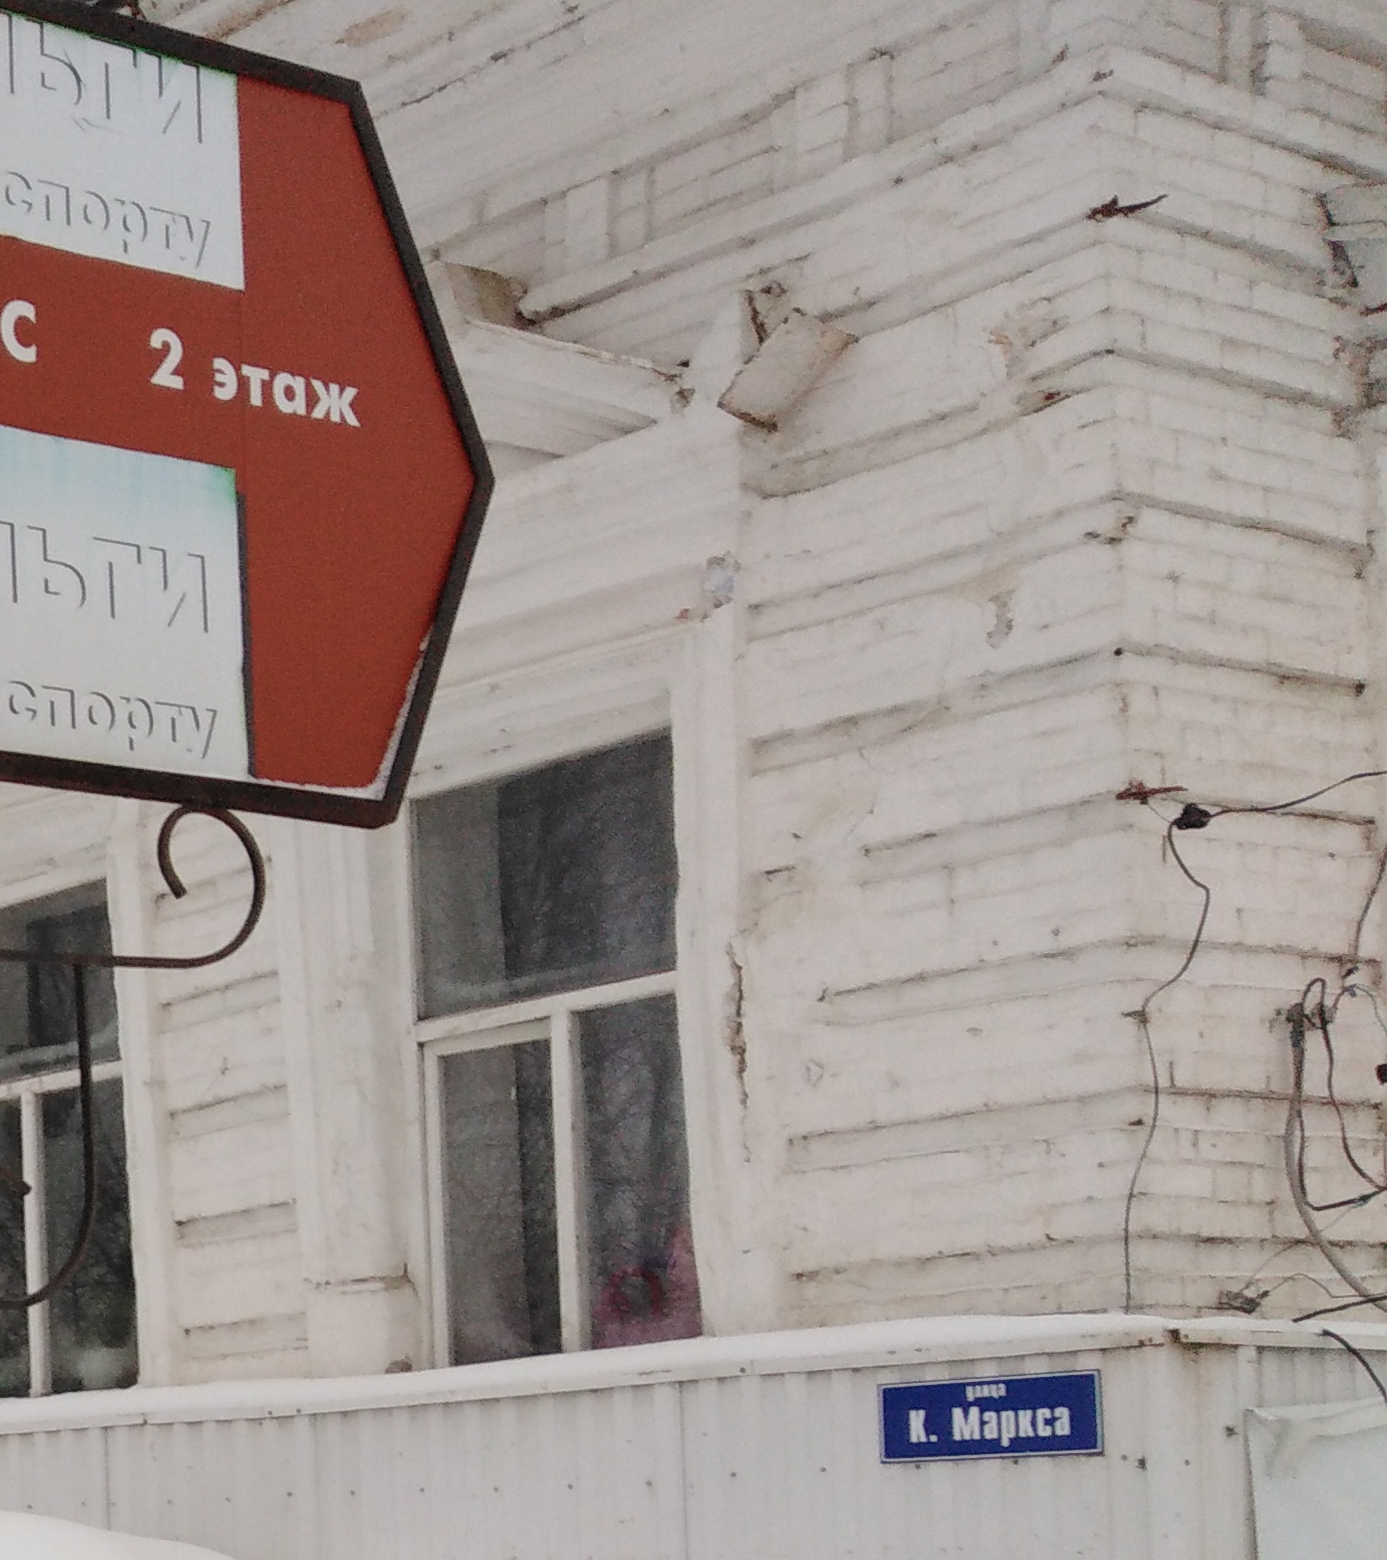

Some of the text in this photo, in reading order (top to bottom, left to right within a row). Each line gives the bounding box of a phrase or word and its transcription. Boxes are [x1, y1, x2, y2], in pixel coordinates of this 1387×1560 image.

[149, 327, 363, 428] 2 этаж
[908, 1406, 1072, 1447] К. Маркса
